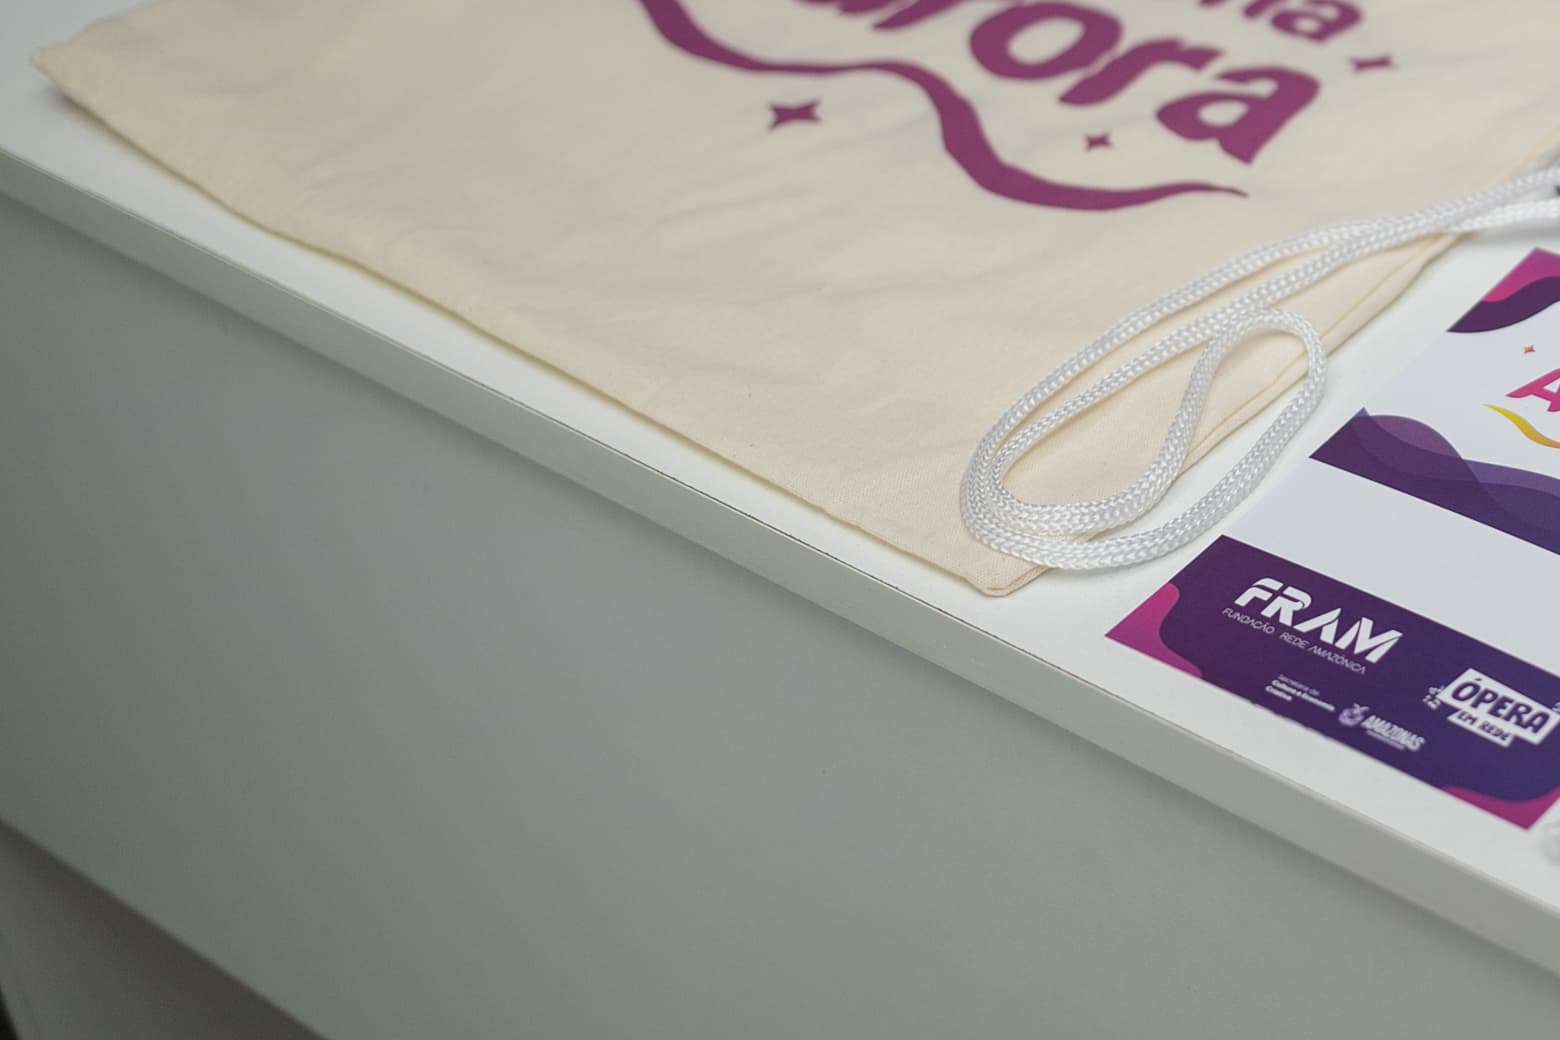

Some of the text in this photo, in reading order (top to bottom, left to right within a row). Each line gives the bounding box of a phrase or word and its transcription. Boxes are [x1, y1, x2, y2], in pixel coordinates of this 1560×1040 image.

[1222, 608, 1275, 635] FUNDAÇÃO
[1280, 631, 1309, 649] REDE
[1233, 577, 1404, 664] FRAM
[1451, 677, 1550, 734] ÓPERA
[1457, 709, 1513, 742] EM REDE
[1360, 714, 1426, 751] AMAZONAS
